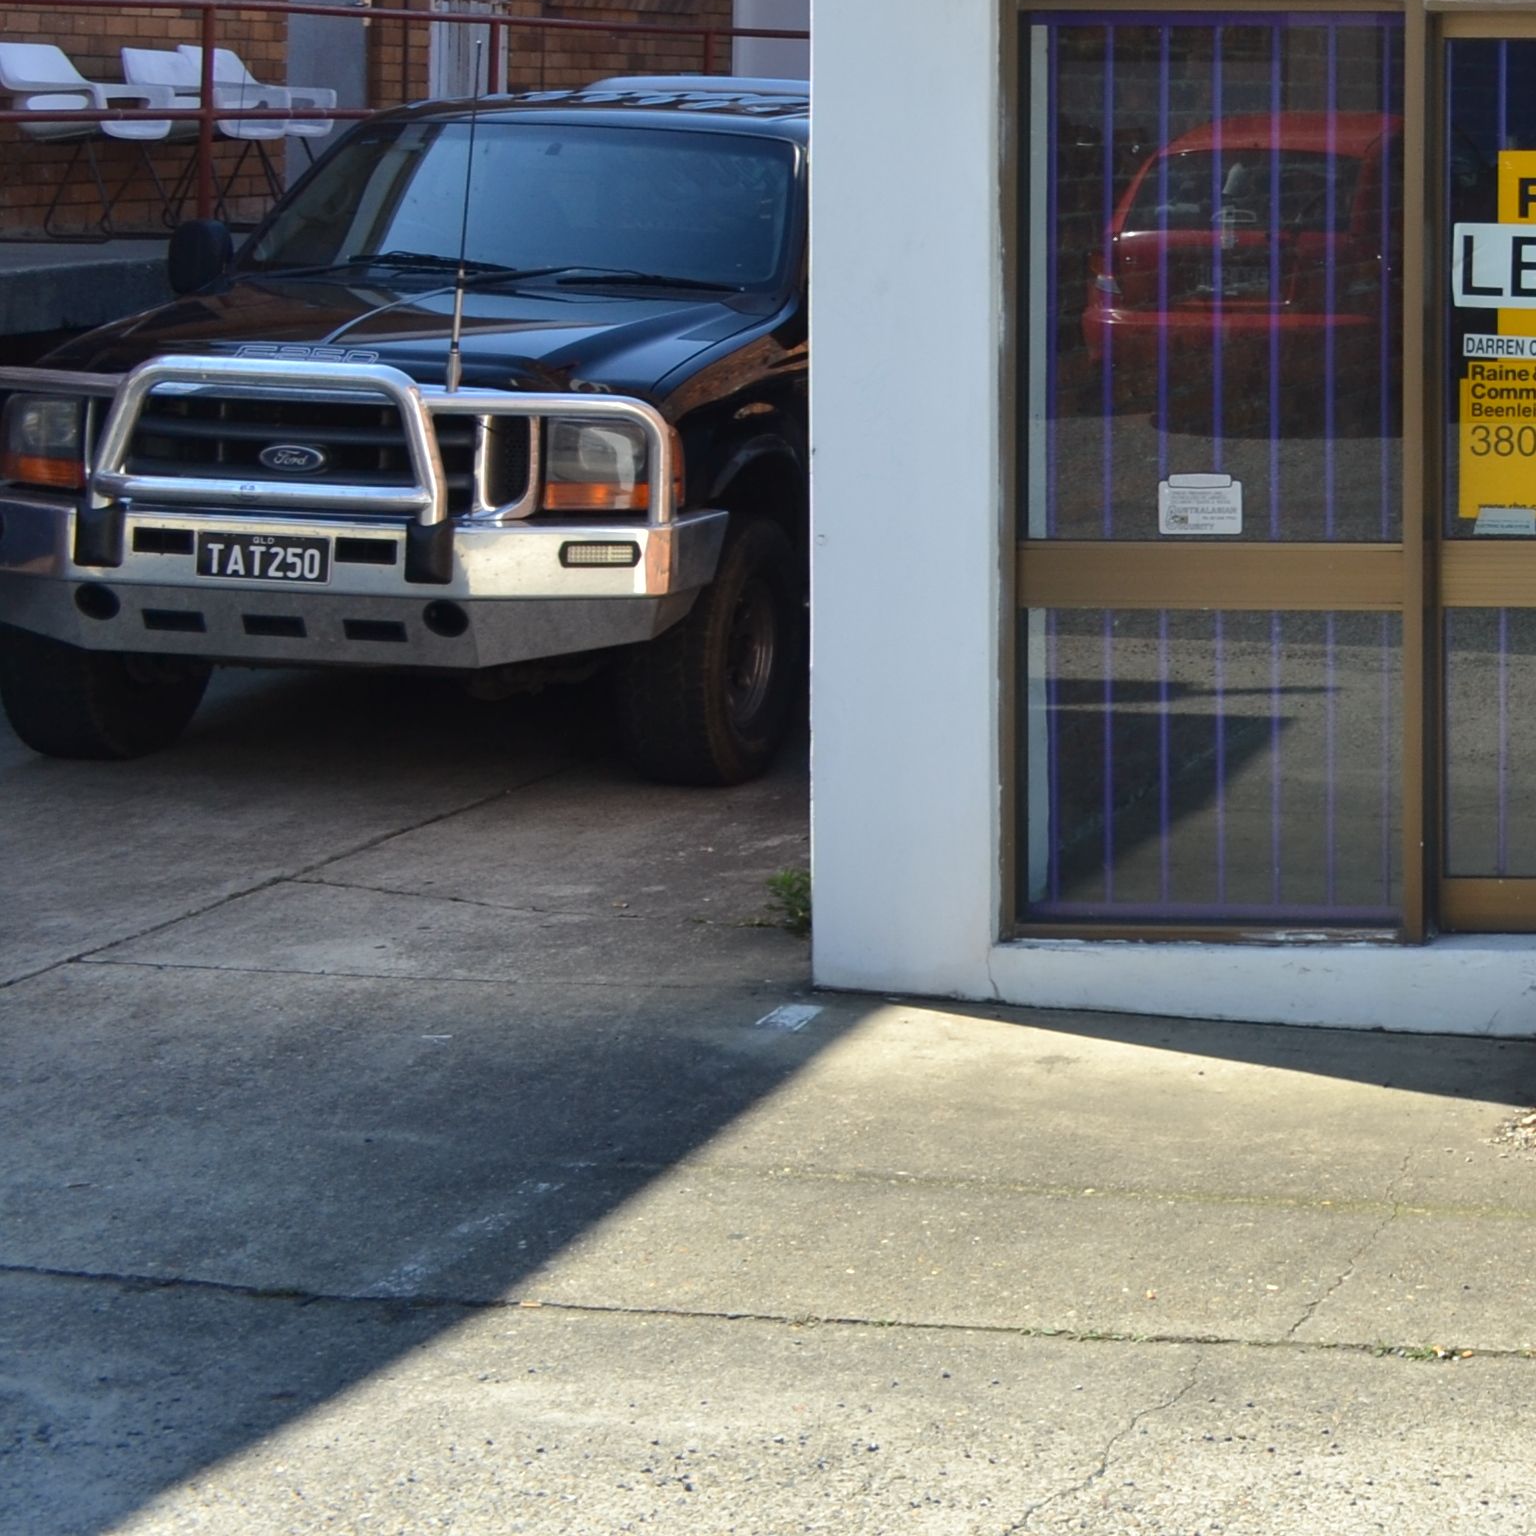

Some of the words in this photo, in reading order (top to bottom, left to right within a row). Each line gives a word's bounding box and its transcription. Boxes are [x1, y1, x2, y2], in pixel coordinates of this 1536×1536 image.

[1465, 336, 1525, 356] DARREN
[1470, 365, 1530, 381] Raine
[273, 448, 309, 465] Ford
[206, 543, 321, 579] TAT250
